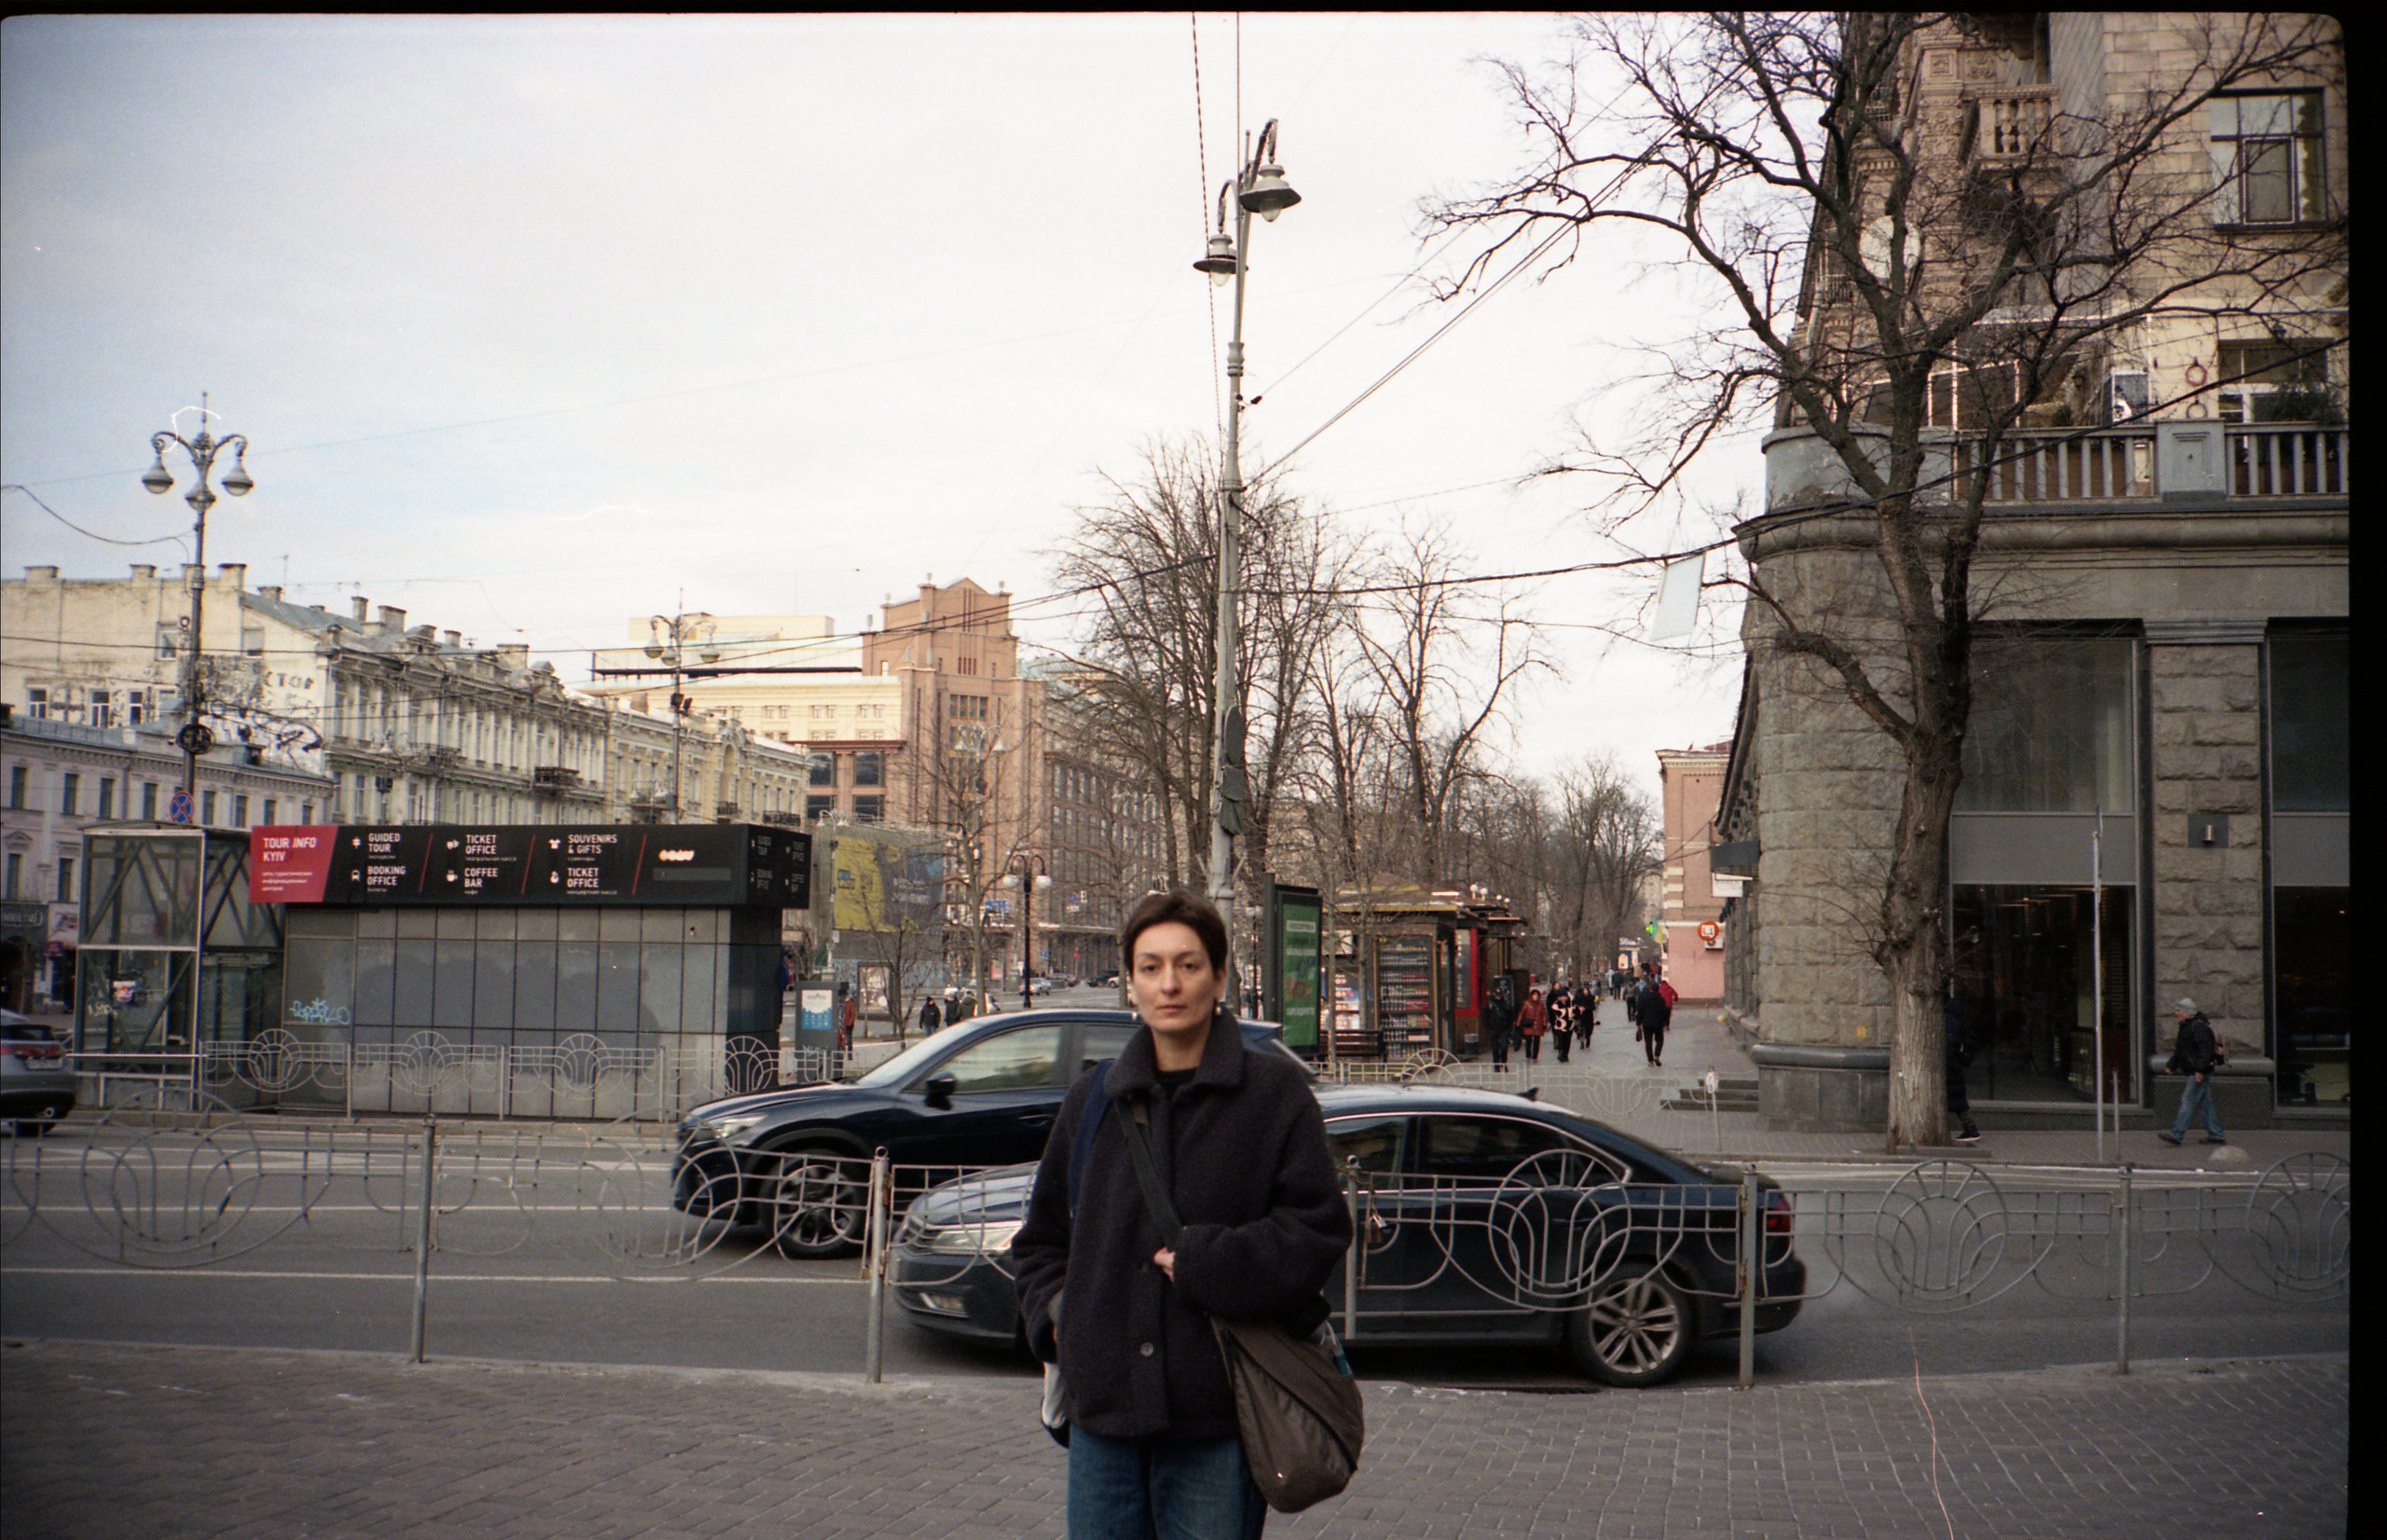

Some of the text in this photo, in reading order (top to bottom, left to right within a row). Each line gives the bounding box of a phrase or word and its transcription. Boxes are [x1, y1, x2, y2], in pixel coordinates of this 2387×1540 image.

[367, 832, 401, 842] GUIDED
[465, 834, 497, 844] TICKET
[568, 834, 617, 844] SOUVENIRS
[263, 837, 317, 848] TOUR INFO
[367, 843, 392, 853] TOUR
[465, 845, 497, 855] OFFICE
[568, 845, 602, 854] & GIFTS
[262, 851, 286, 862] KYIV
[366, 865, 406, 875] BOOKING
[464, 868, 499, 877] COFFEE
[567, 867, 599, 877] TICKET
[366, 876, 398, 886] OFFICE
[464, 878, 483, 887] BAR
[567, 878, 599, 887] OFFICE
